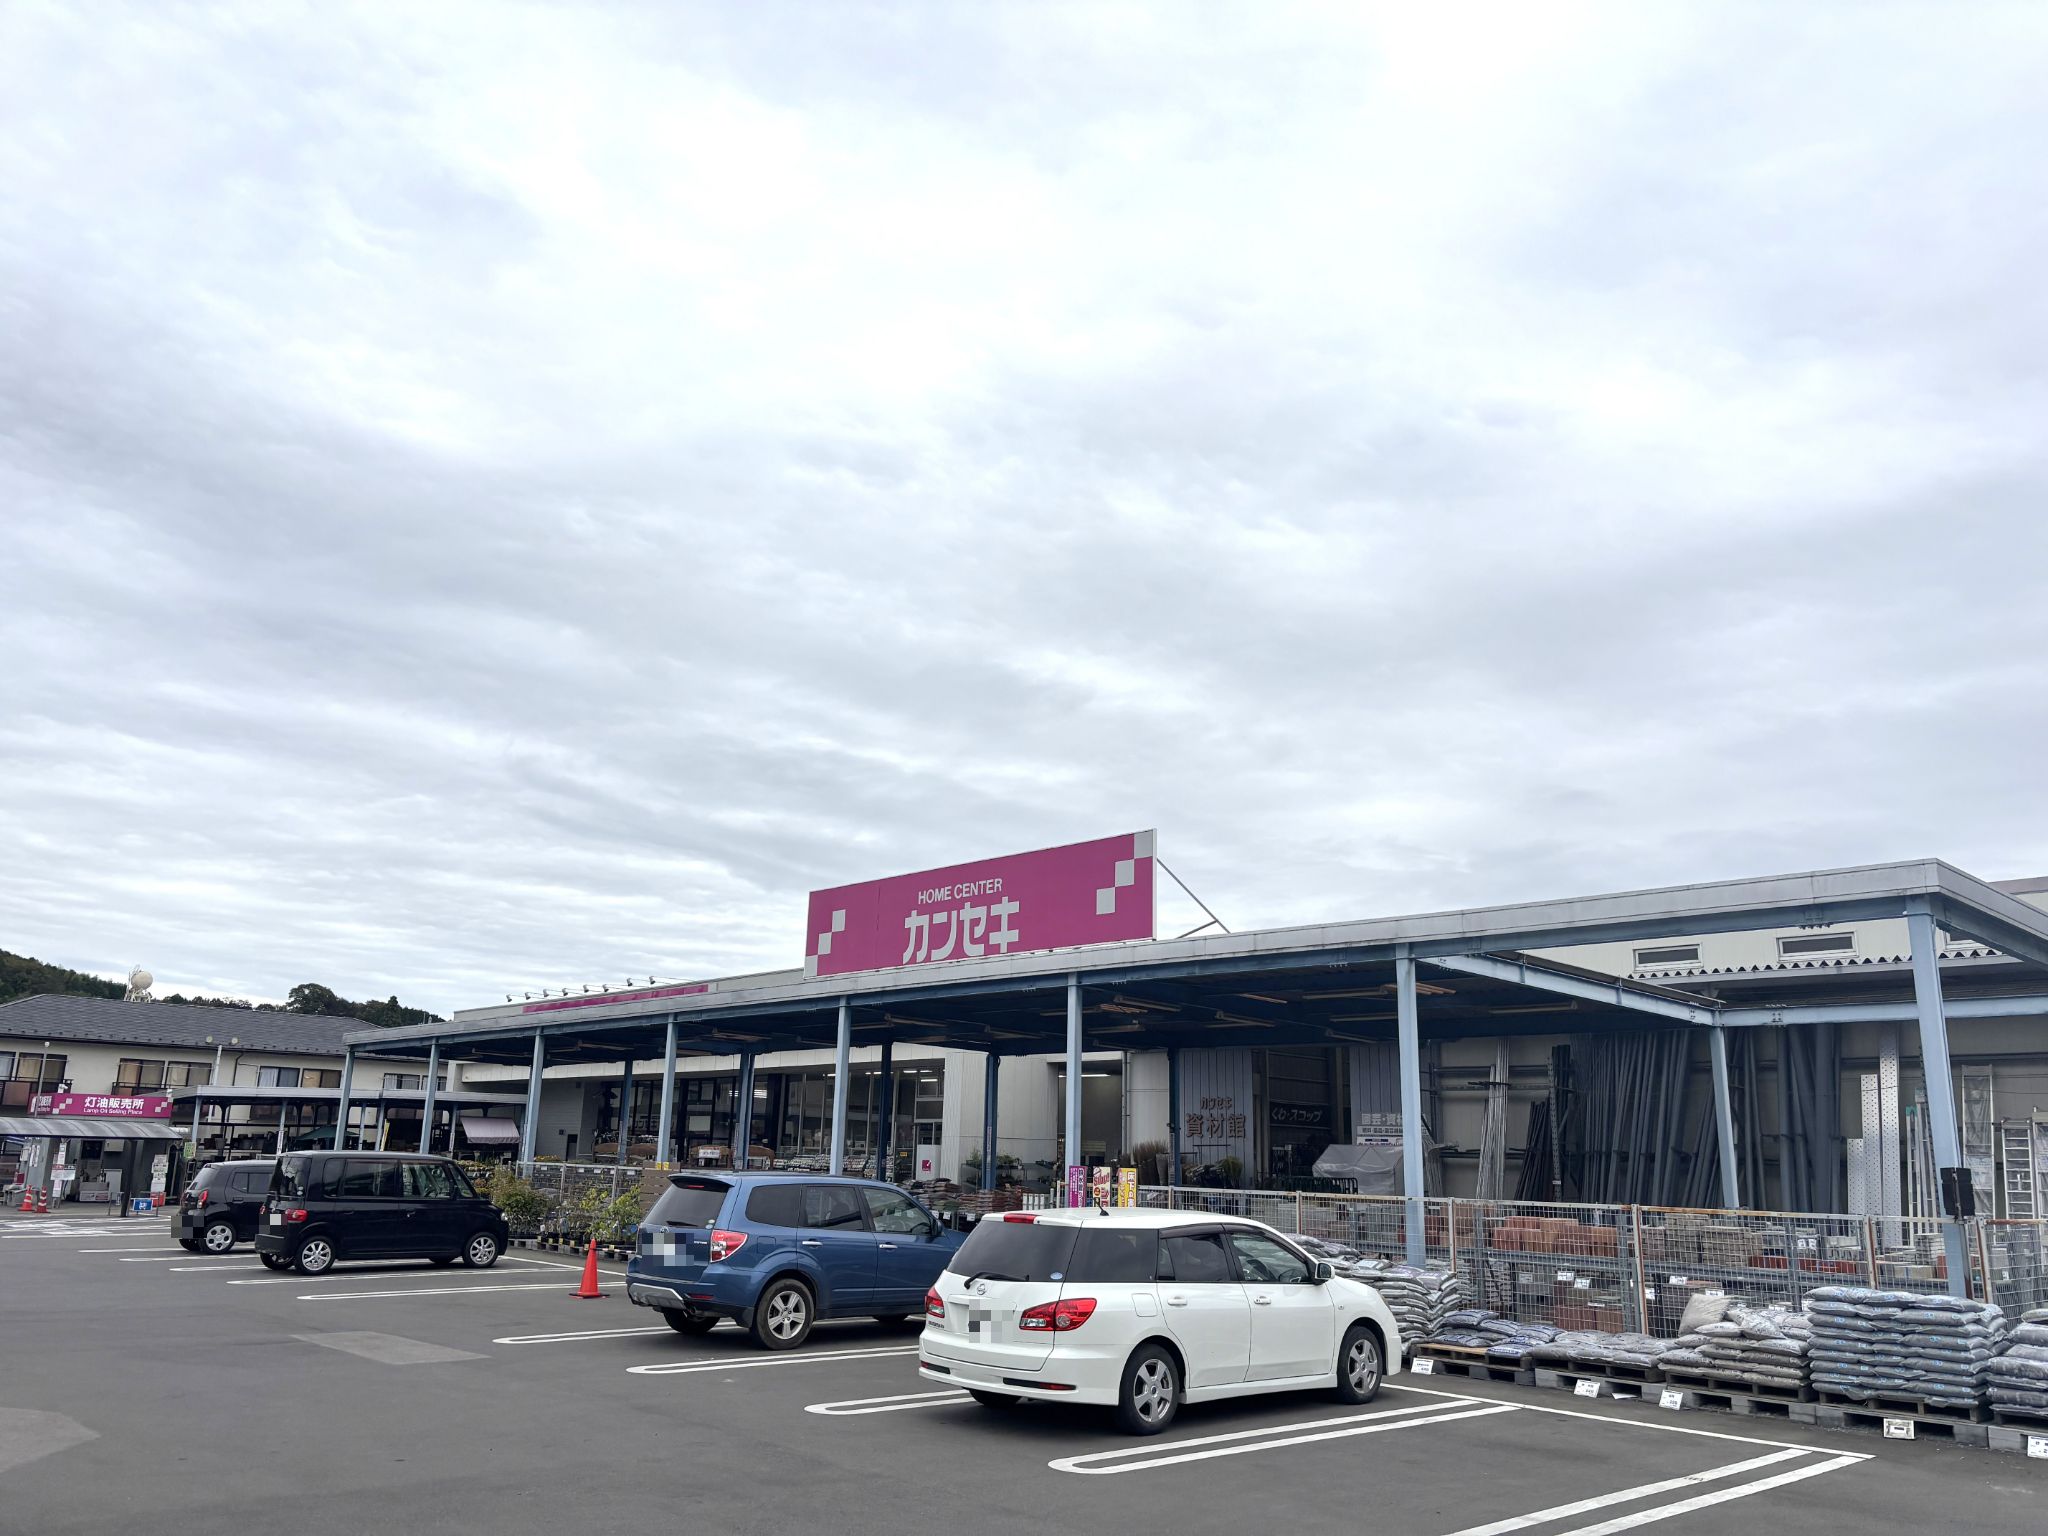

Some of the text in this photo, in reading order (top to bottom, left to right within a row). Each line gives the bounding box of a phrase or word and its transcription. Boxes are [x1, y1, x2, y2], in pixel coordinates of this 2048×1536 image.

[918, 878, 1003, 905] HOME CENTER
[902, 896, 1020, 965] カンセキ
[84, 1096, 145, 1110] 灯油販売所
[1186, 1112, 1247, 1139] 資材館
